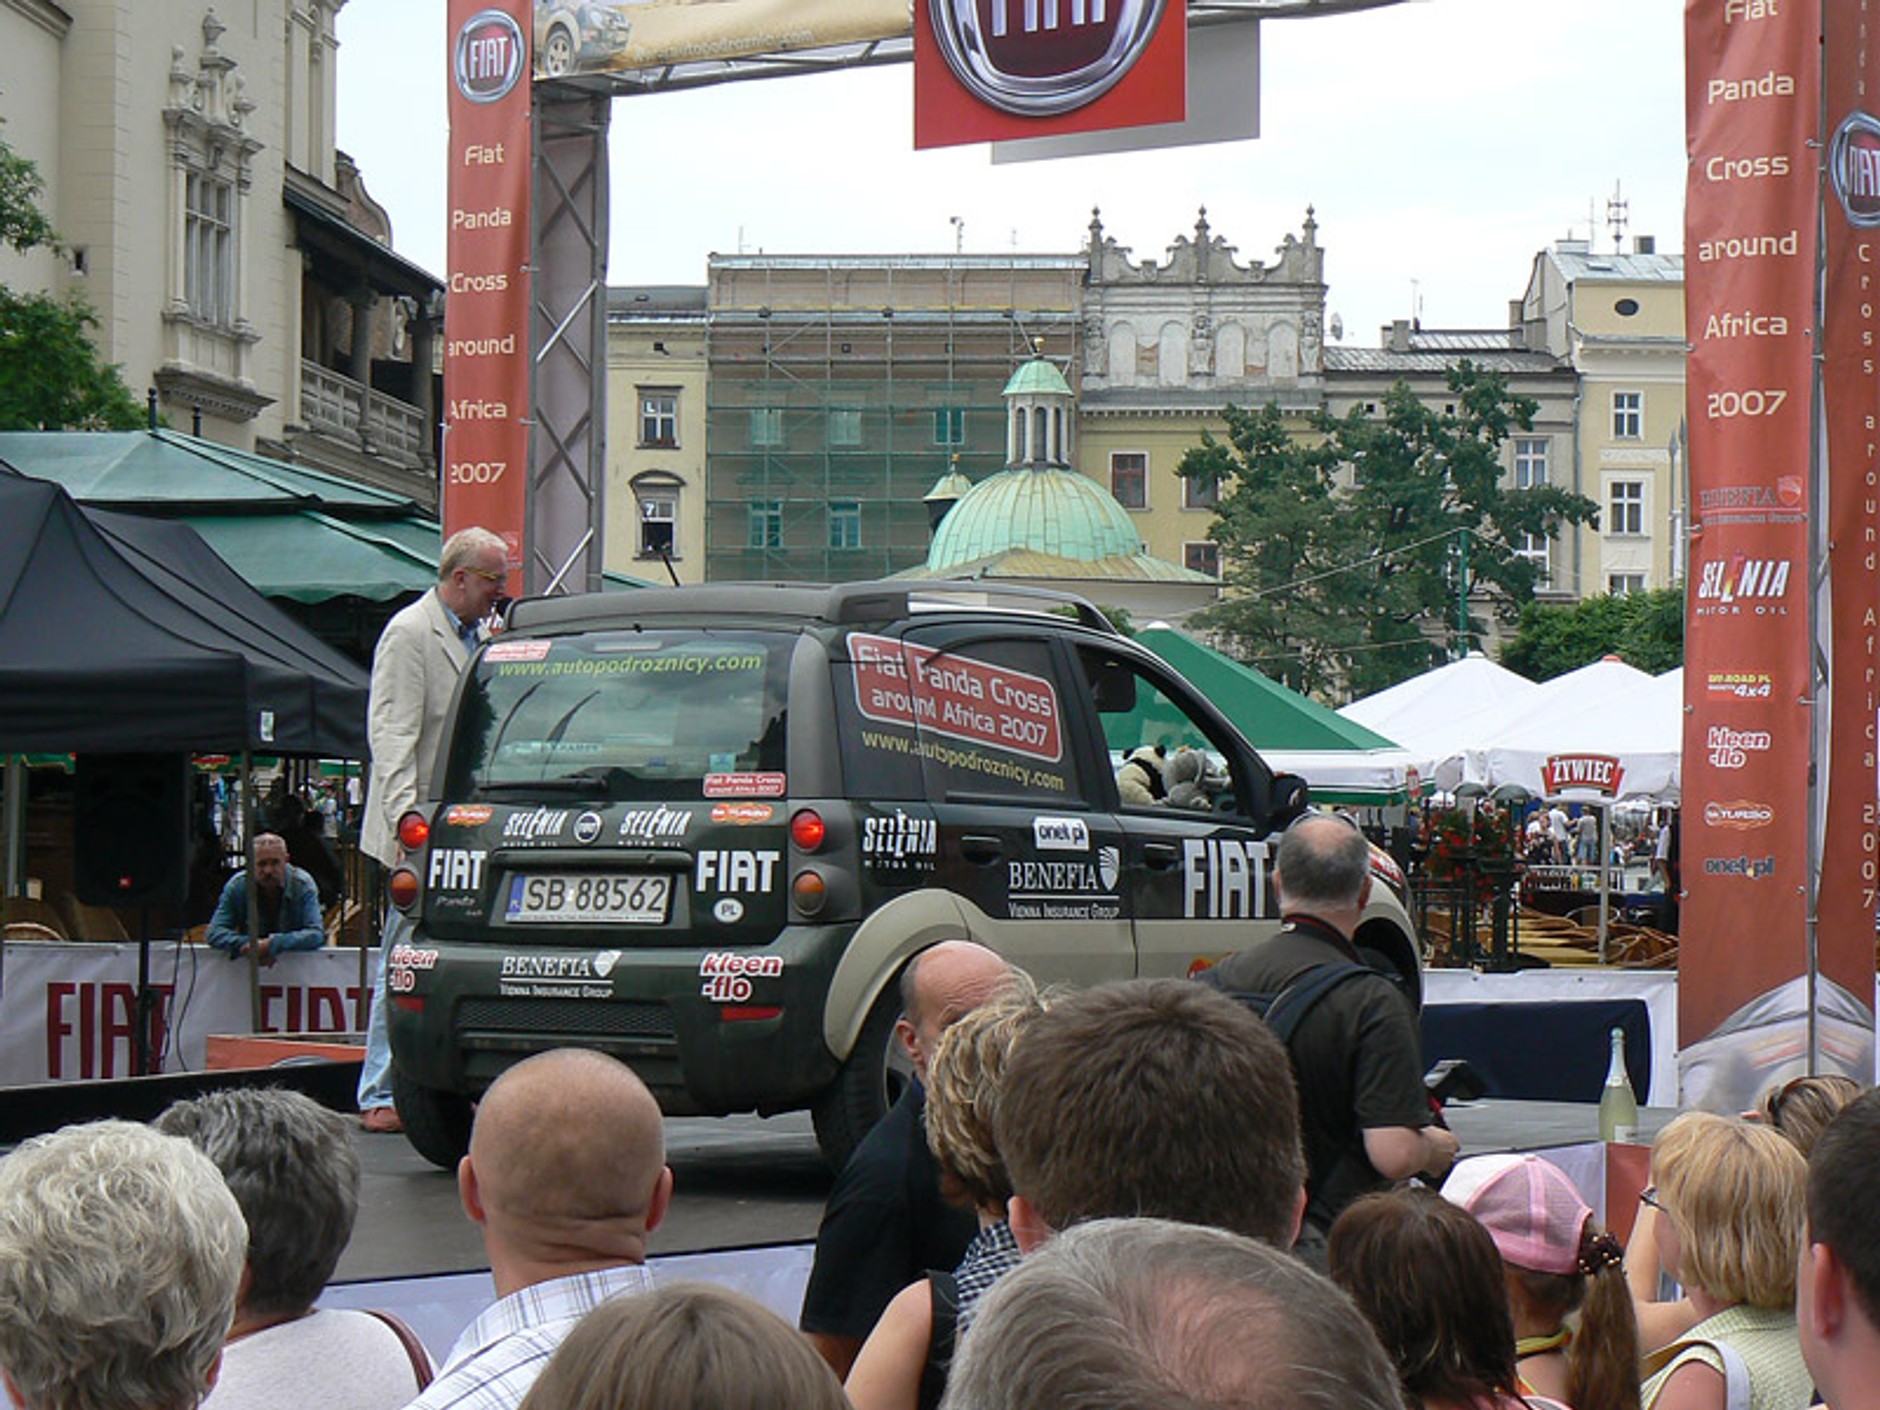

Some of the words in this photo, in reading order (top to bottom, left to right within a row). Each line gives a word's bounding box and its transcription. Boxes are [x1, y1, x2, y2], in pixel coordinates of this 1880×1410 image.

[1725, 0, 1778, 23] Fiat
[470, 38, 508, 79] FIAT
[1708, 71, 1795, 105] Panda
[465, 144, 504, 166] Fiat
[1706, 155, 1790, 181] Cross
[452, 207, 511, 229] Panda
[1699, 230, 1798, 262] around
[451, 273, 508, 293] Cross
[1703, 310, 1788, 339] Africa
[448, 334, 515, 356] around
[451, 400, 508, 420] Africa
[1707, 390, 1787, 418] 2007
[450, 463, 506, 483] 2007
[1696, 606, 1741, 616] MTOR
[499, 653, 762, 678] www.autopodroznicy.com
[857, 644, 909, 680] Fiat
[914, 655, 984, 699] Panda
[990, 679, 1052, 717] Cross
[871, 688, 936, 718] around
[942, 701, 994, 734] Africa
[1001, 715, 1048, 746] 2007
[1708, 728, 1770, 749] kleen
[1552, 757, 1613, 784] ŻYWIEC
[503, 806, 568, 839] SELENIA
[620, 804, 692, 838] SELENIA
[428, 849, 487, 890] FIAT
[1862, 804, 1875, 908] 2007
[696, 851, 781, 892] FIAT
[1008, 863, 1098, 891] BENEFIA
[1184, 839, 1271, 918] FIAT
[527, 879, 566, 911] SB
[576, 879, 666, 912] 88562
[721, 903, 737, 916] PL
[501, 957, 592, 977] BENEFIA
[701, 953, 784, 976] kleen
[47, 981, 176, 1079] FIAT
